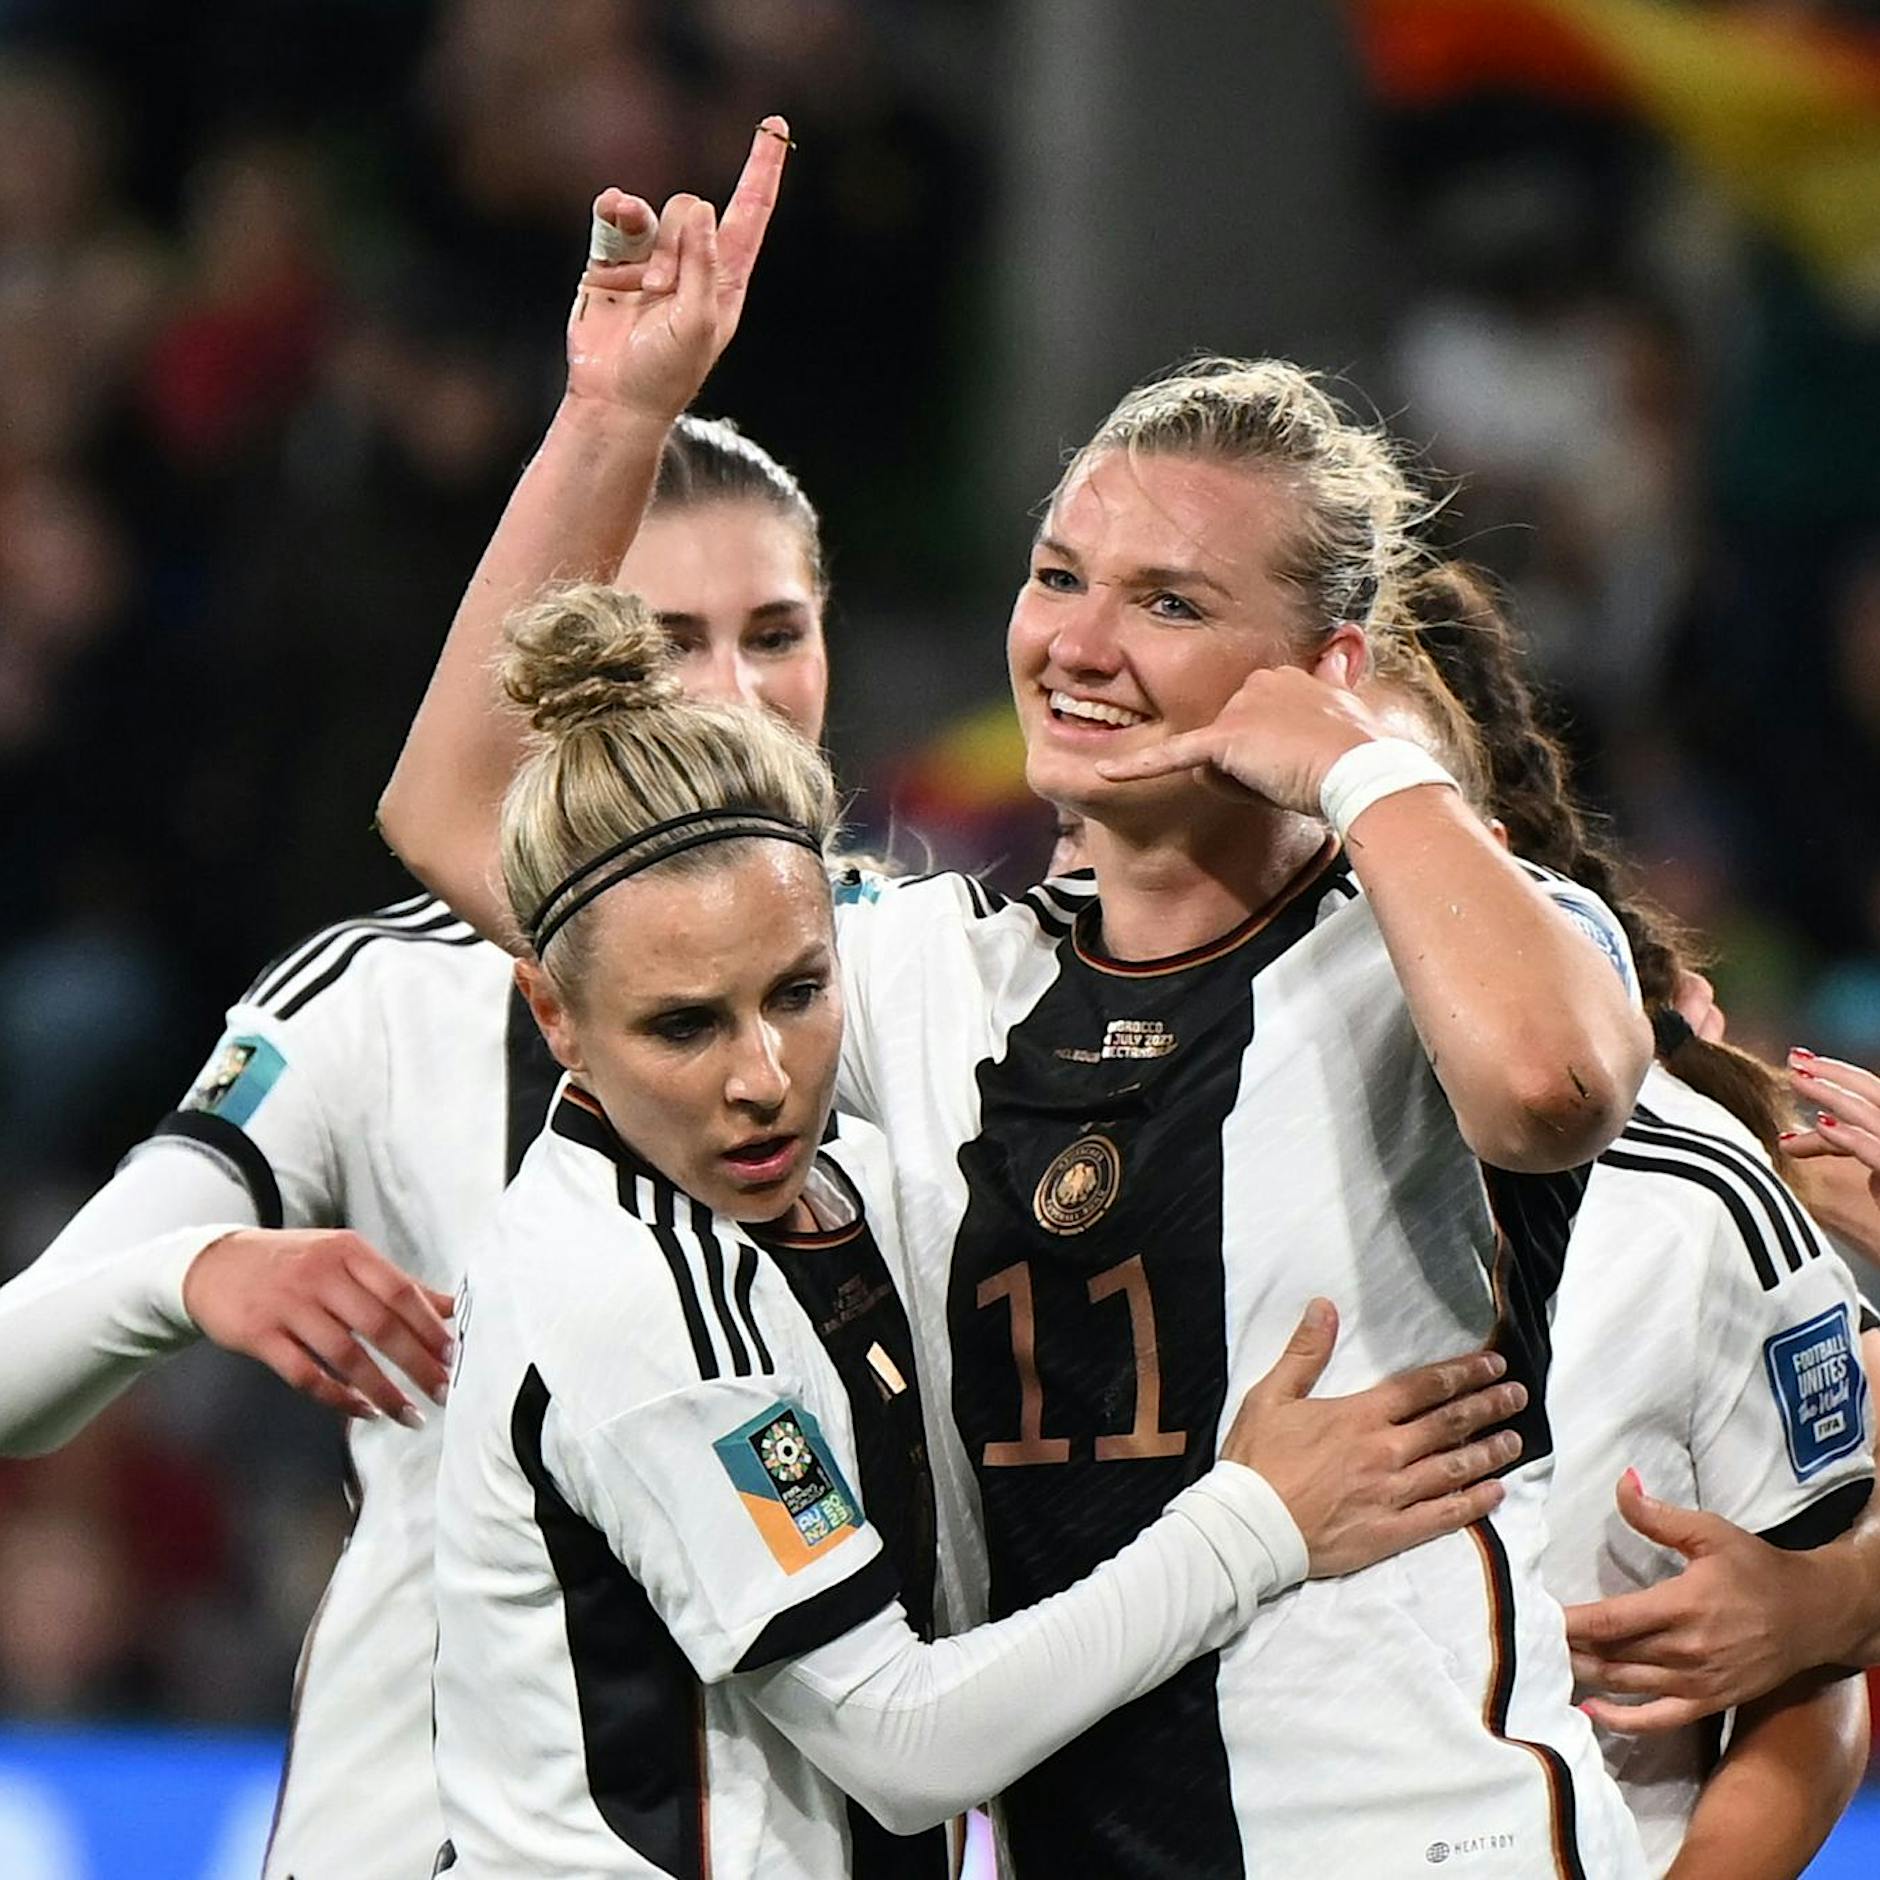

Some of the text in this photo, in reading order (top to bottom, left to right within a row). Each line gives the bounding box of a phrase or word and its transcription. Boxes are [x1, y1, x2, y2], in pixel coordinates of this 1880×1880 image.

[1113, 1033, 1143, 1046] JULY
[976, 1253, 1187, 1466] 11
[1792, 1333, 1849, 1374] FOOTBALL
[1797, 1353, 1847, 1400] UNITES
[1817, 1416, 1842, 1437] FIFA
